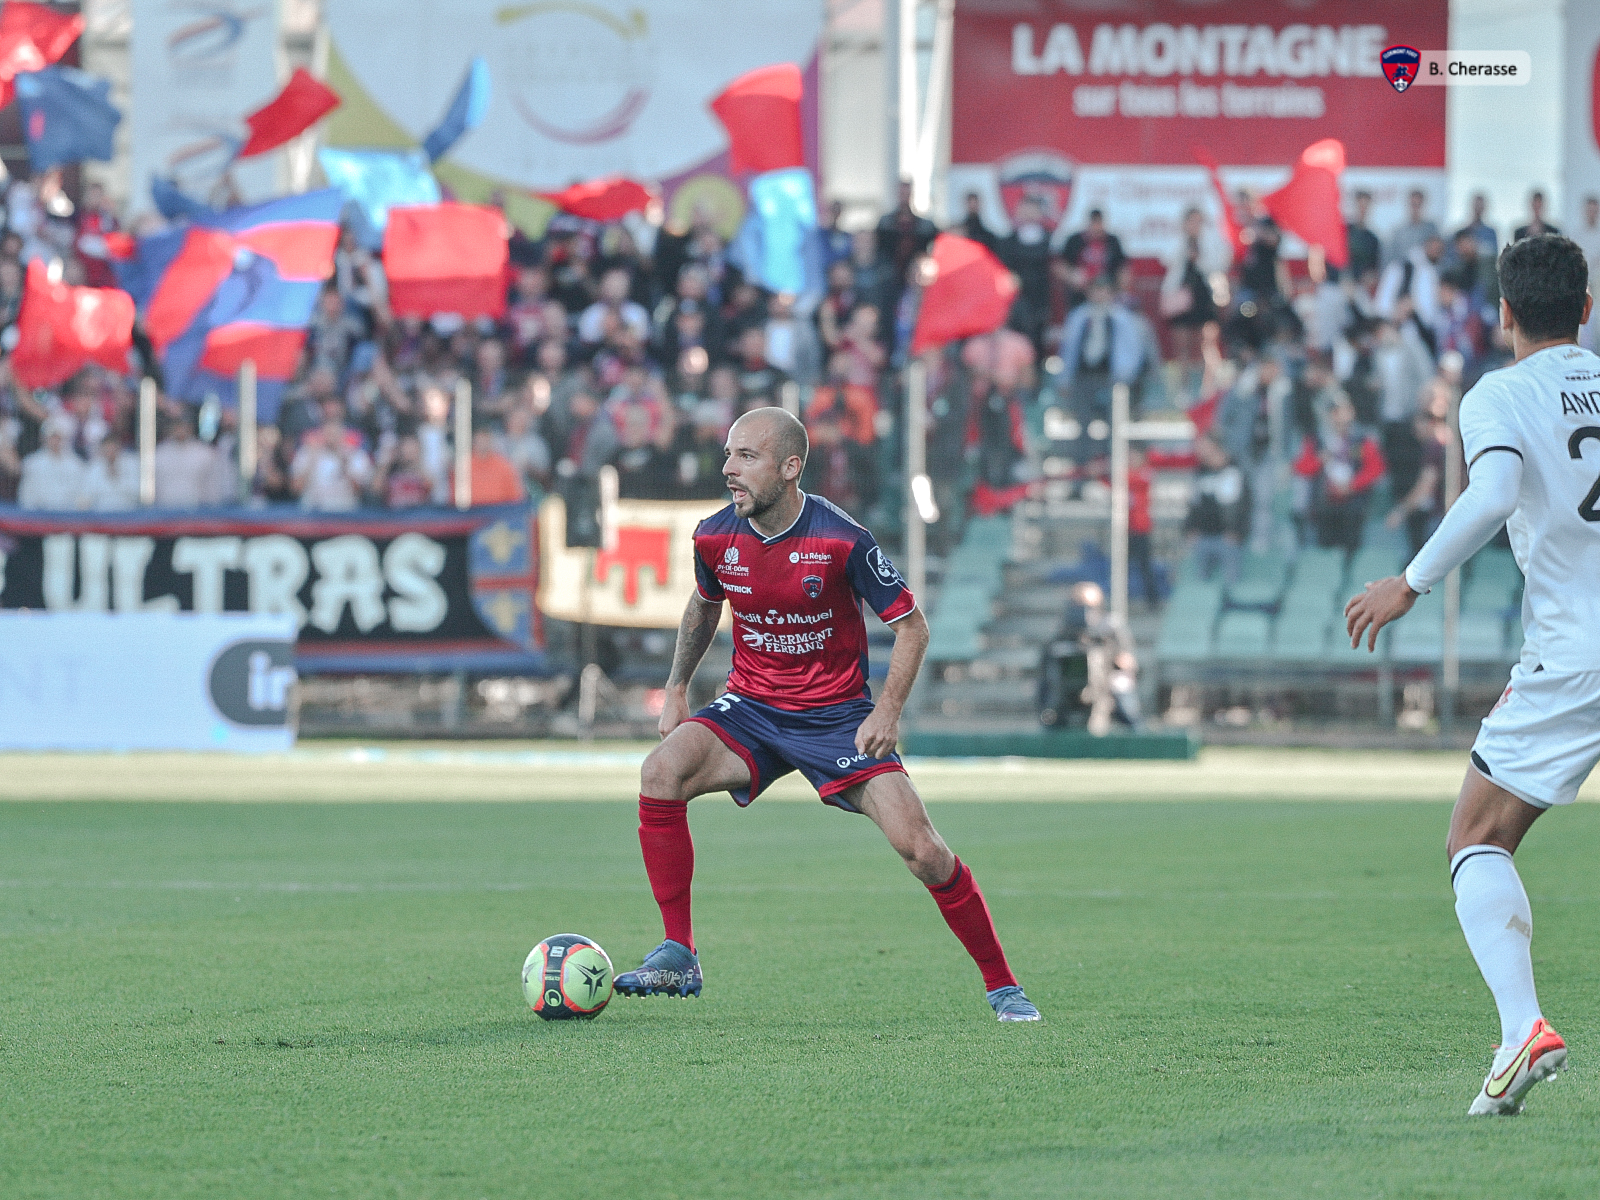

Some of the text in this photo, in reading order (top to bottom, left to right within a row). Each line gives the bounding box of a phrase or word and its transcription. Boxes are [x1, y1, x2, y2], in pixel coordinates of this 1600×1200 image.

[1011, 22, 1389, 78] LA MONTAGNE
[800, 552, 808, 560] La
[42, 532, 449, 633] ULTRAS
[722, 582, 753, 595] PATRICK
[731, 606, 833, 625] rédit Mutuel
[763, 627, 833, 645] CLERMONT
[764, 640, 824, 655] FERRAND
